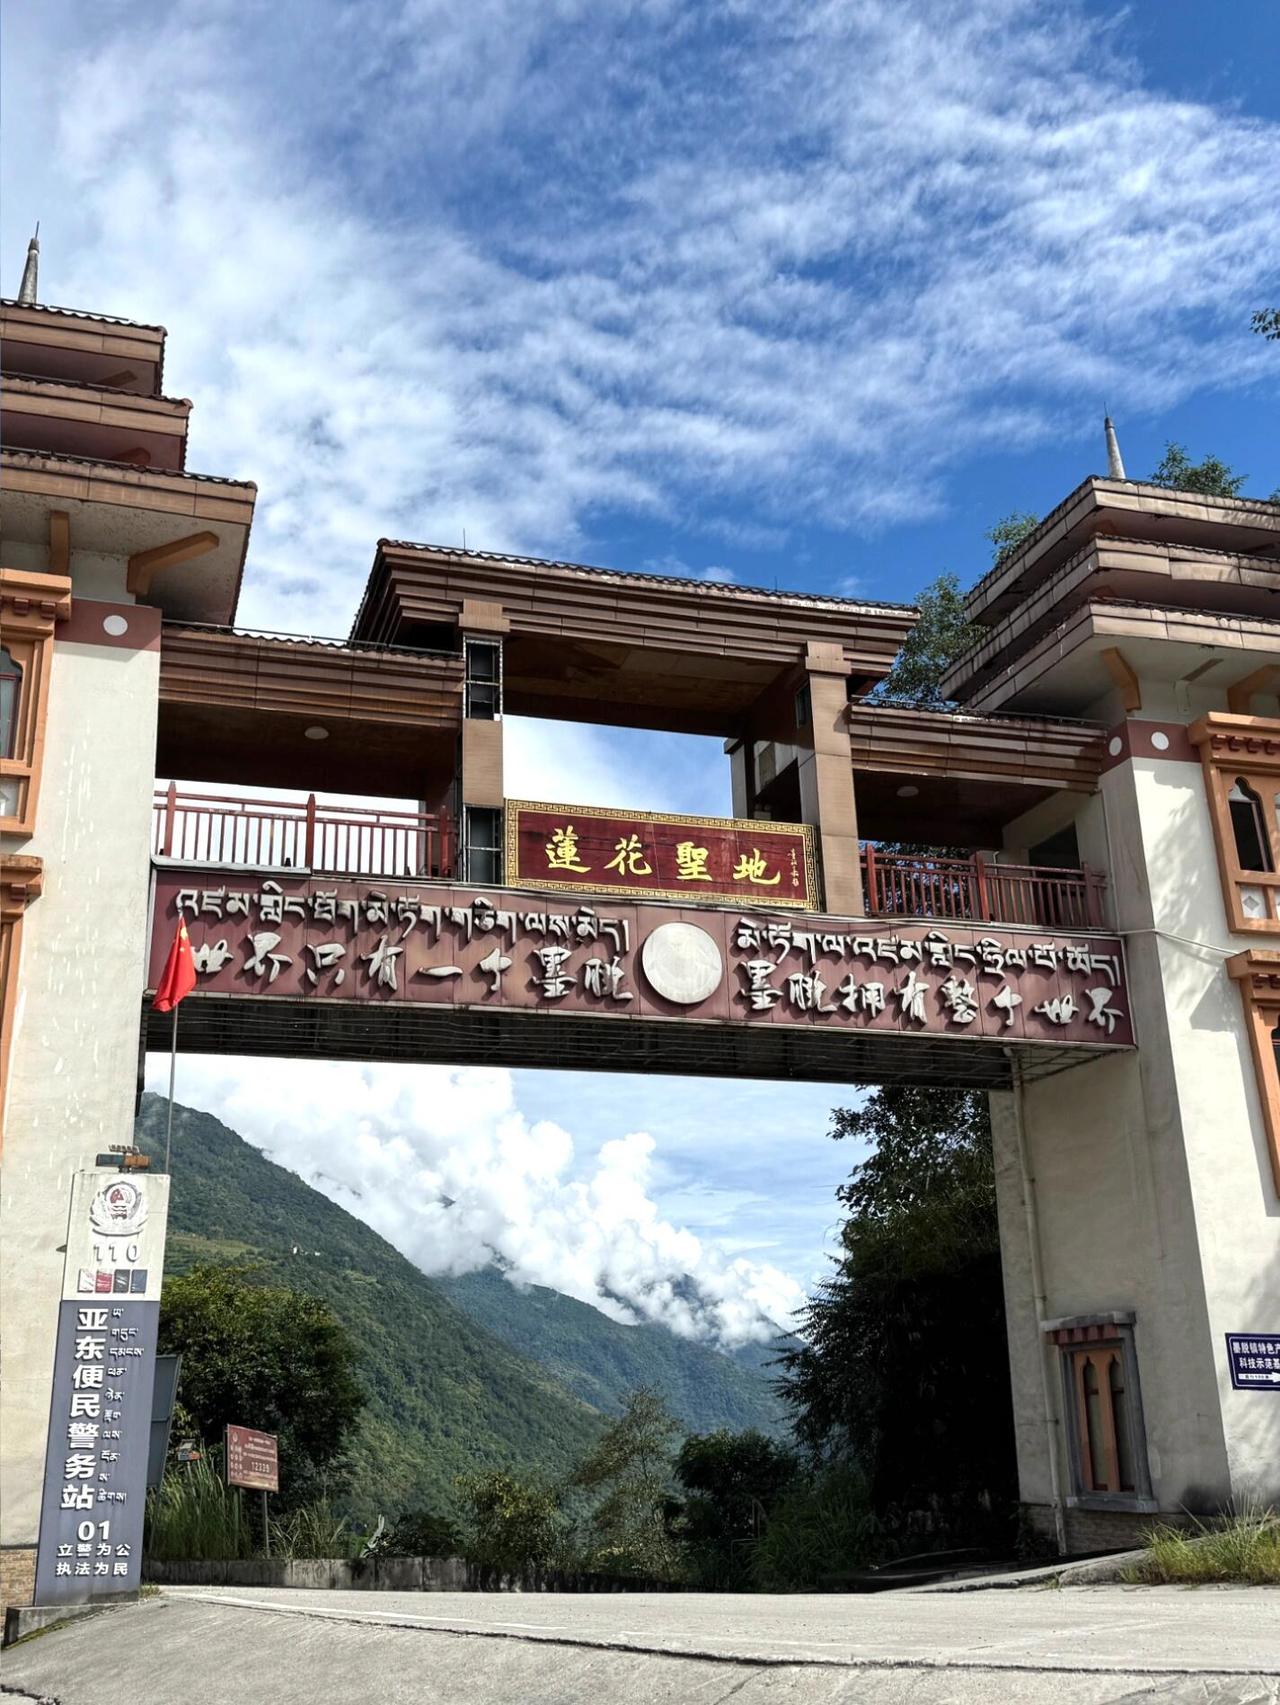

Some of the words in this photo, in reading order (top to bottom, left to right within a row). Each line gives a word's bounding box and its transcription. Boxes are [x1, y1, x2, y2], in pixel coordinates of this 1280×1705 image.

[545, 825, 781, 885] 蓮花聖地
[92, 1243, 141, 1263] 110
[61, 1308, 109, 1510] 亚东便民警务站
[78, 1520, 110, 1541] 01
[57, 1543, 131, 1557] 立警为公
[56, 1562, 128, 1576] 执法为民
